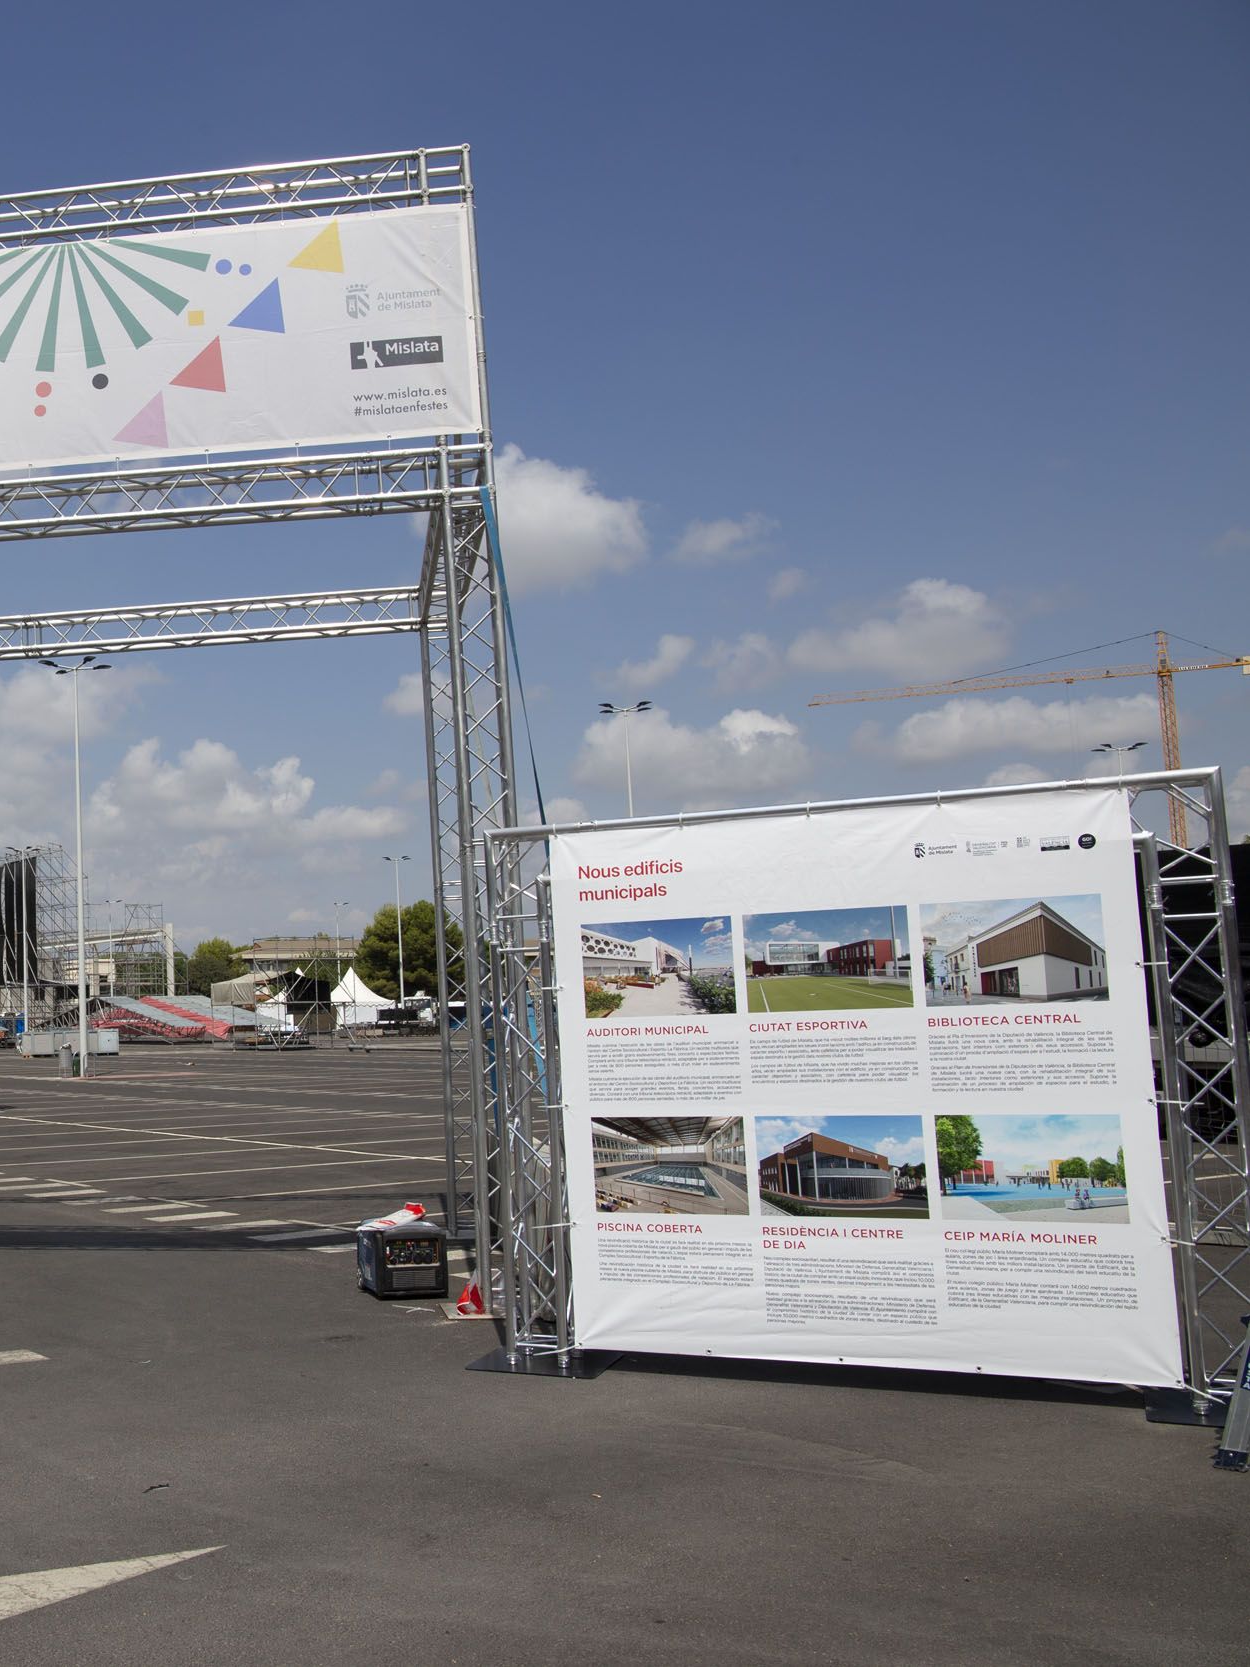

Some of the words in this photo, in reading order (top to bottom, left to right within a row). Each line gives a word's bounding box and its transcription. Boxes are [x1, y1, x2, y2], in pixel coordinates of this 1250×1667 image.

[377, 288, 441, 301] Ajuntament
[378, 303, 391, 312] de
[394, 300, 432, 310] Mislata
[386, 340, 439, 355] Mislata
[353, 386, 447, 402] www.mislata.es
[354, 400, 448, 416] #mislataenfestes
[578, 866, 620, 880] Nous
[624, 858, 683, 876] edificis
[580, 883, 668, 902] municipals
[749, 1022, 792, 1032] CIUTAT
[797, 1020, 868, 1031] ESPORTIVA
[928, 1016, 1010, 1027] BIBLIOTECA
[1014, 1014, 1082, 1025] CENTRAL
[587, 1027, 641, 1037] AUDITORI
[645, 1026, 709, 1036] MUNICIPAL
[598, 1222, 642, 1232] PISCINA
[647, 1224, 703, 1234] COBERTA
[762, 1226, 839, 1237] RESIDÈNCIA
[844, 1228, 847, 1237] I
[851, 1229, 904, 1239] CENTRE
[944, 1231, 975, 1241] CEIP
[980, 1230, 1026, 1242] MARÍA
[1031, 1233, 1098, 1244] MOLINER
[763, 1240, 780, 1248] DE
[784, 1240, 806, 1249] DIA
